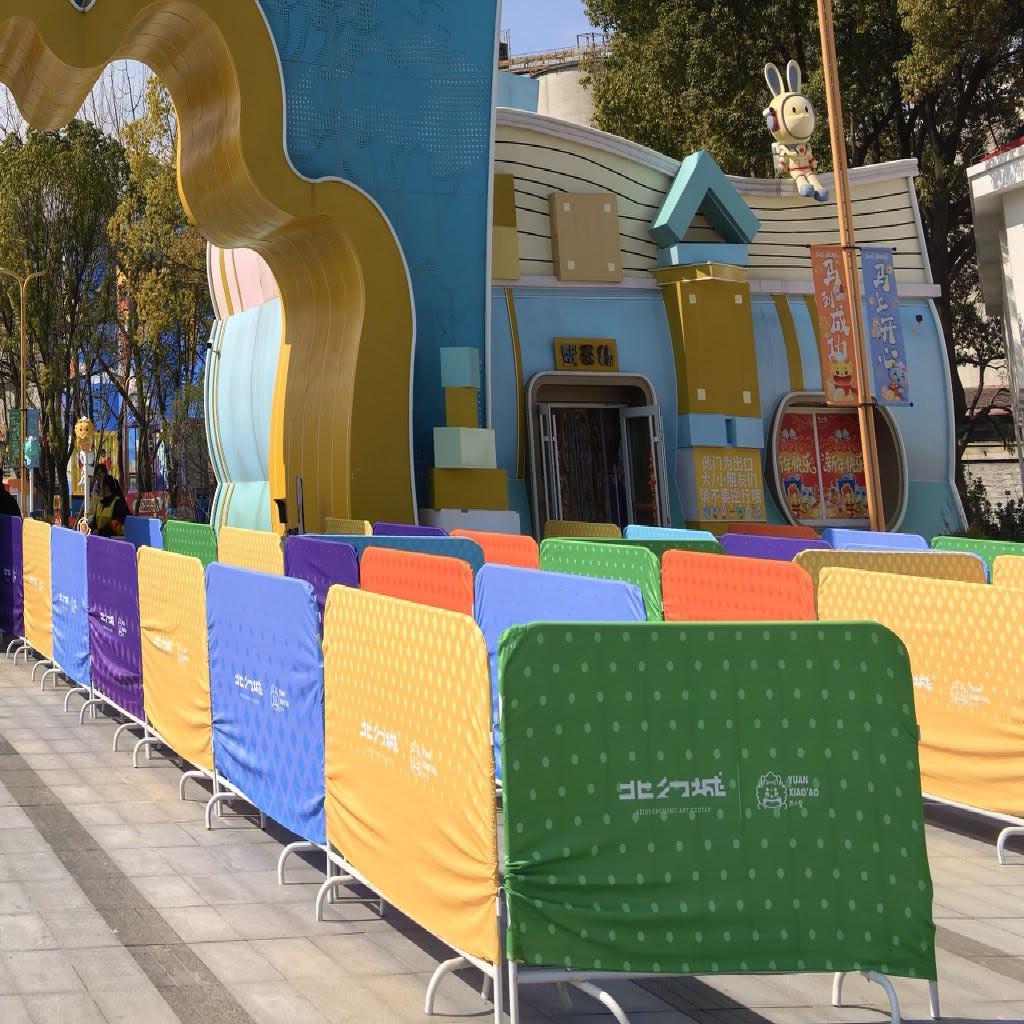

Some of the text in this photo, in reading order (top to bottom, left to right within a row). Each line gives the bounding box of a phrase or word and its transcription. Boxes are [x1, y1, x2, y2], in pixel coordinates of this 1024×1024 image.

[821, 258, 850, 362] 马到成功
[872, 262, 902, 370] 马上开心
[702, 455, 753, 472] 此门为出口
[701, 471, 758, 488] 大/小朋友们
[788, 775, 808, 784] YUAN
[788, 787, 819, 797] XIAO'AO
